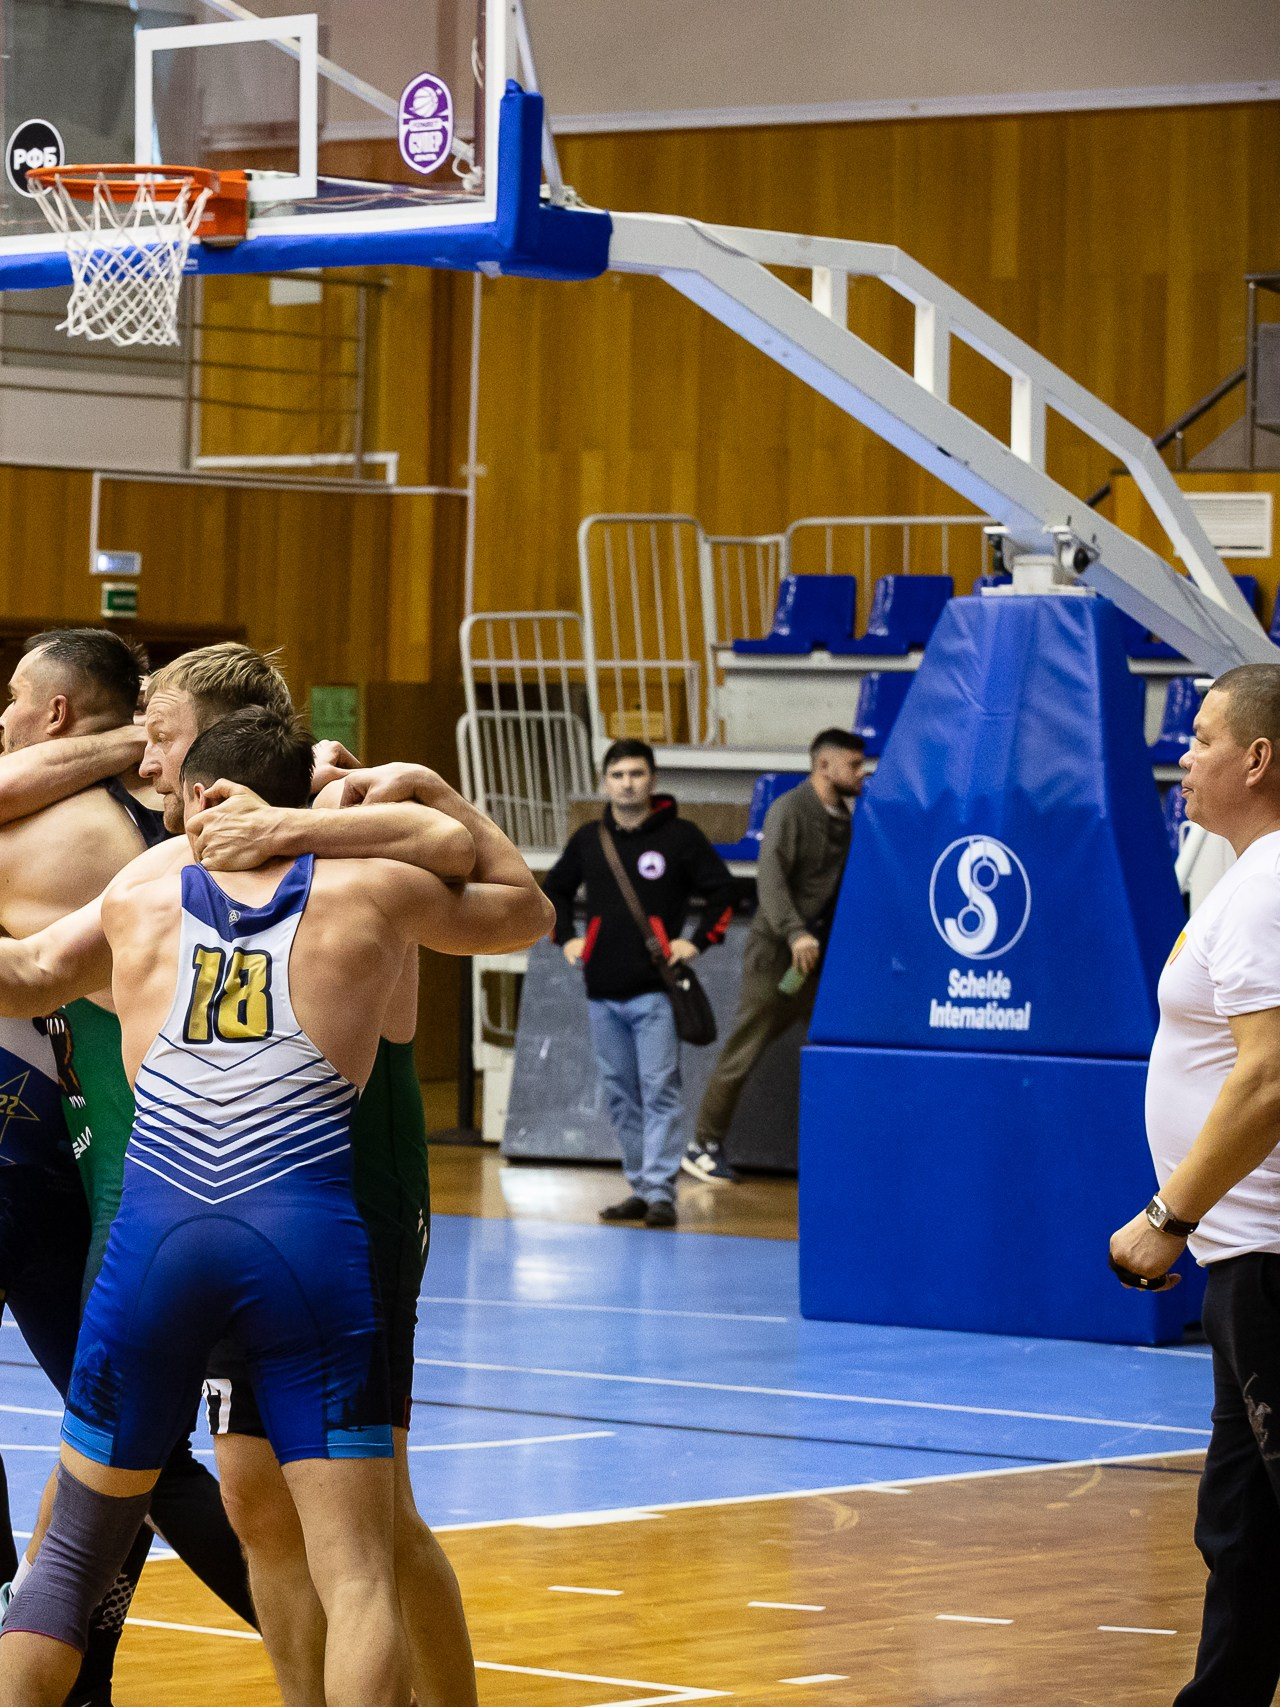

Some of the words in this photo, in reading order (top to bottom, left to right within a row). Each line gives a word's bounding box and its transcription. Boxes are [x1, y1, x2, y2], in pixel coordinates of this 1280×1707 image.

[13, 146, 58, 170] РФБ
[183, 943, 274, 1044] 18
[947, 968, 1012, 1000] Schelde
[929, 998, 1032, 1031] International
[202, 1379, 232, 1434] 7
